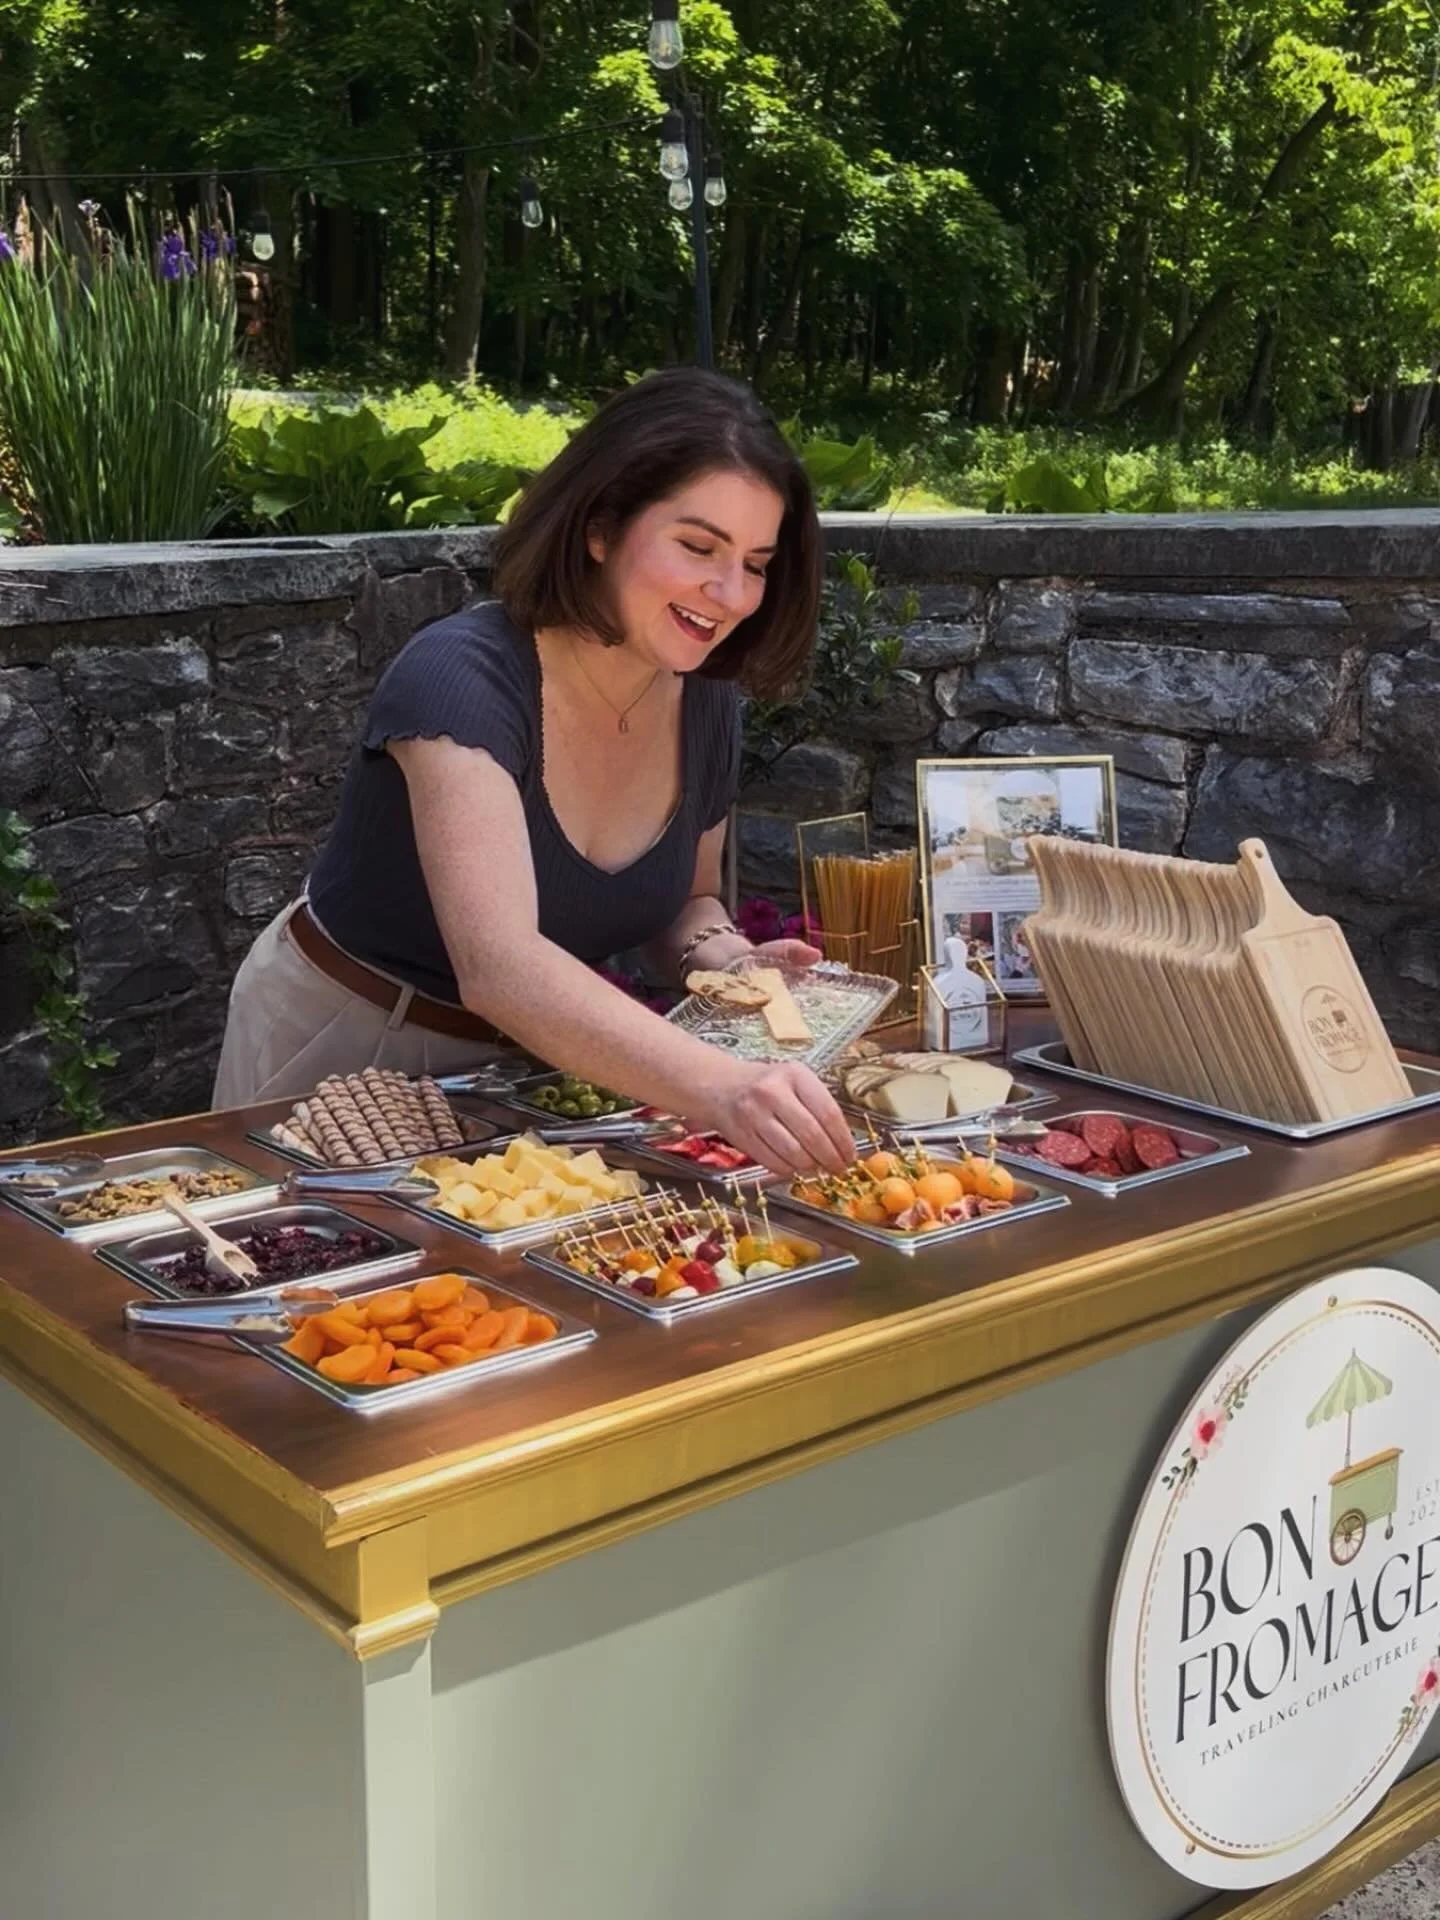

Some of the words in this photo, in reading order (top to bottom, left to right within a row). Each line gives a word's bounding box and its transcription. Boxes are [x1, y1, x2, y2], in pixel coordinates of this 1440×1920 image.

[1180, 1495, 1317, 1643] BON
[1407, 1499, 1440, 1527] 202
[1176, 1535, 1440, 1744] FROMAGE
[1199, 1702, 1299, 1766] TRAVELING
[1305, 1636, 1419, 1709] CHARCUTERIE
